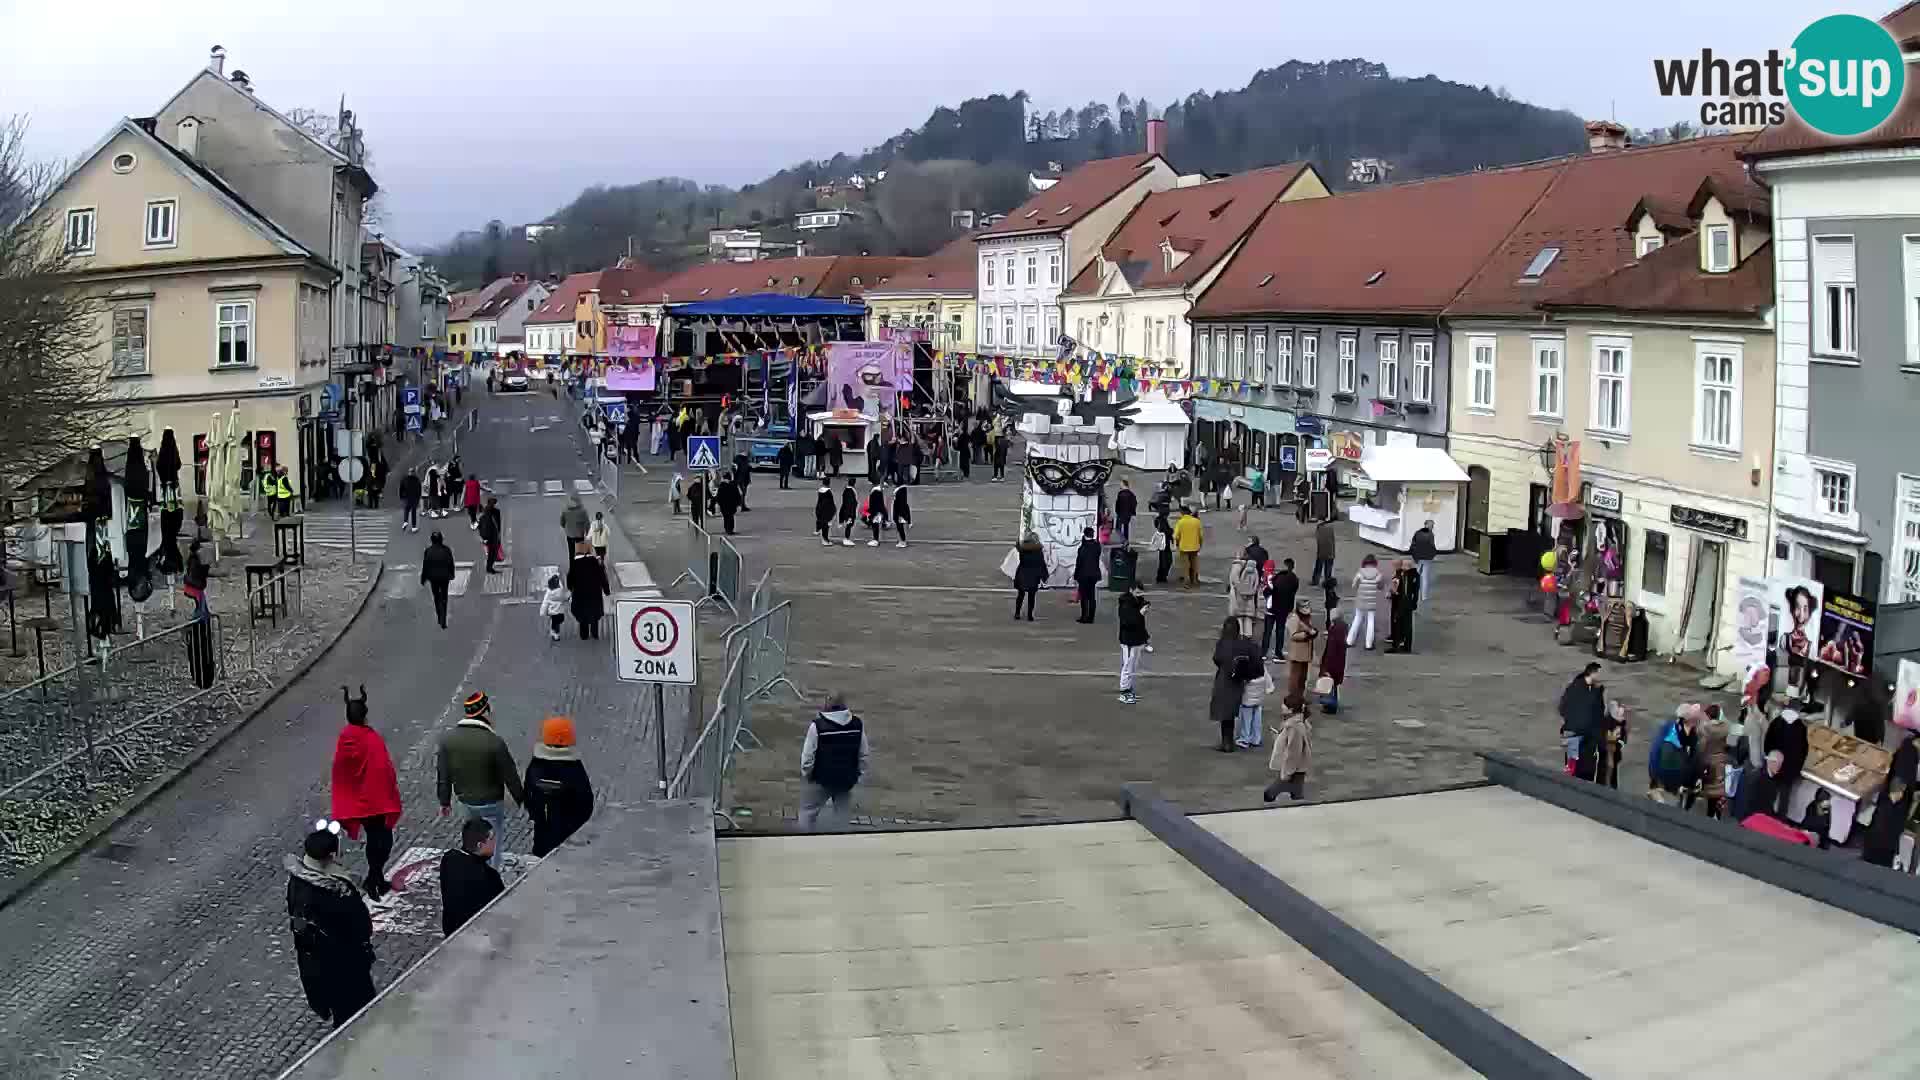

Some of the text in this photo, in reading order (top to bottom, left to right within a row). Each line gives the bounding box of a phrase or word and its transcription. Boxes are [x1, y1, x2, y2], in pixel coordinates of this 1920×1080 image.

[407, 391, 416, 402] P
[643, 622, 667, 642] 30
[634, 659, 678, 676] ZONA
